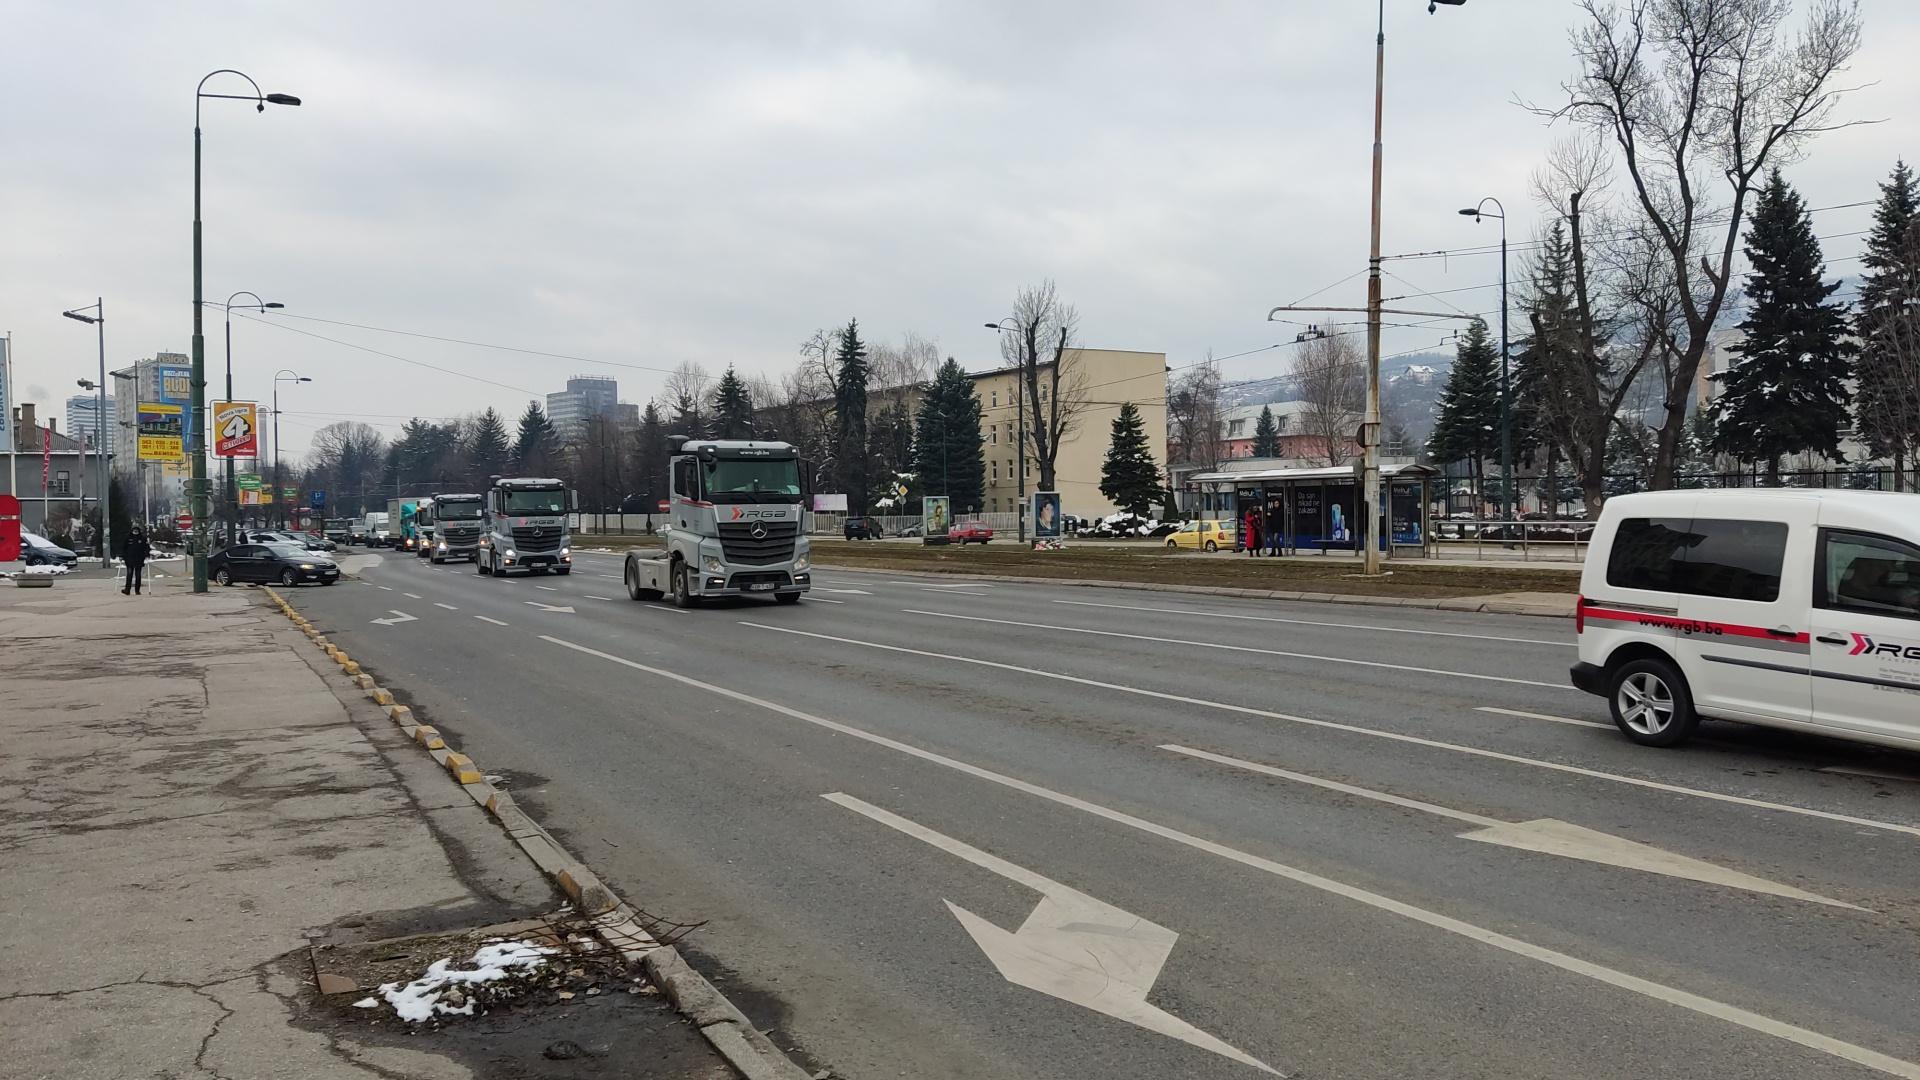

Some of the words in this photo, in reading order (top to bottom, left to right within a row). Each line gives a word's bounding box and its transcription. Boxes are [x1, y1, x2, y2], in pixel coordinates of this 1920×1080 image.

[222, 415, 250, 439] 4
[746, 510, 787, 519] RGB
[1639, 618, 1723, 635] www.rgb.ba
